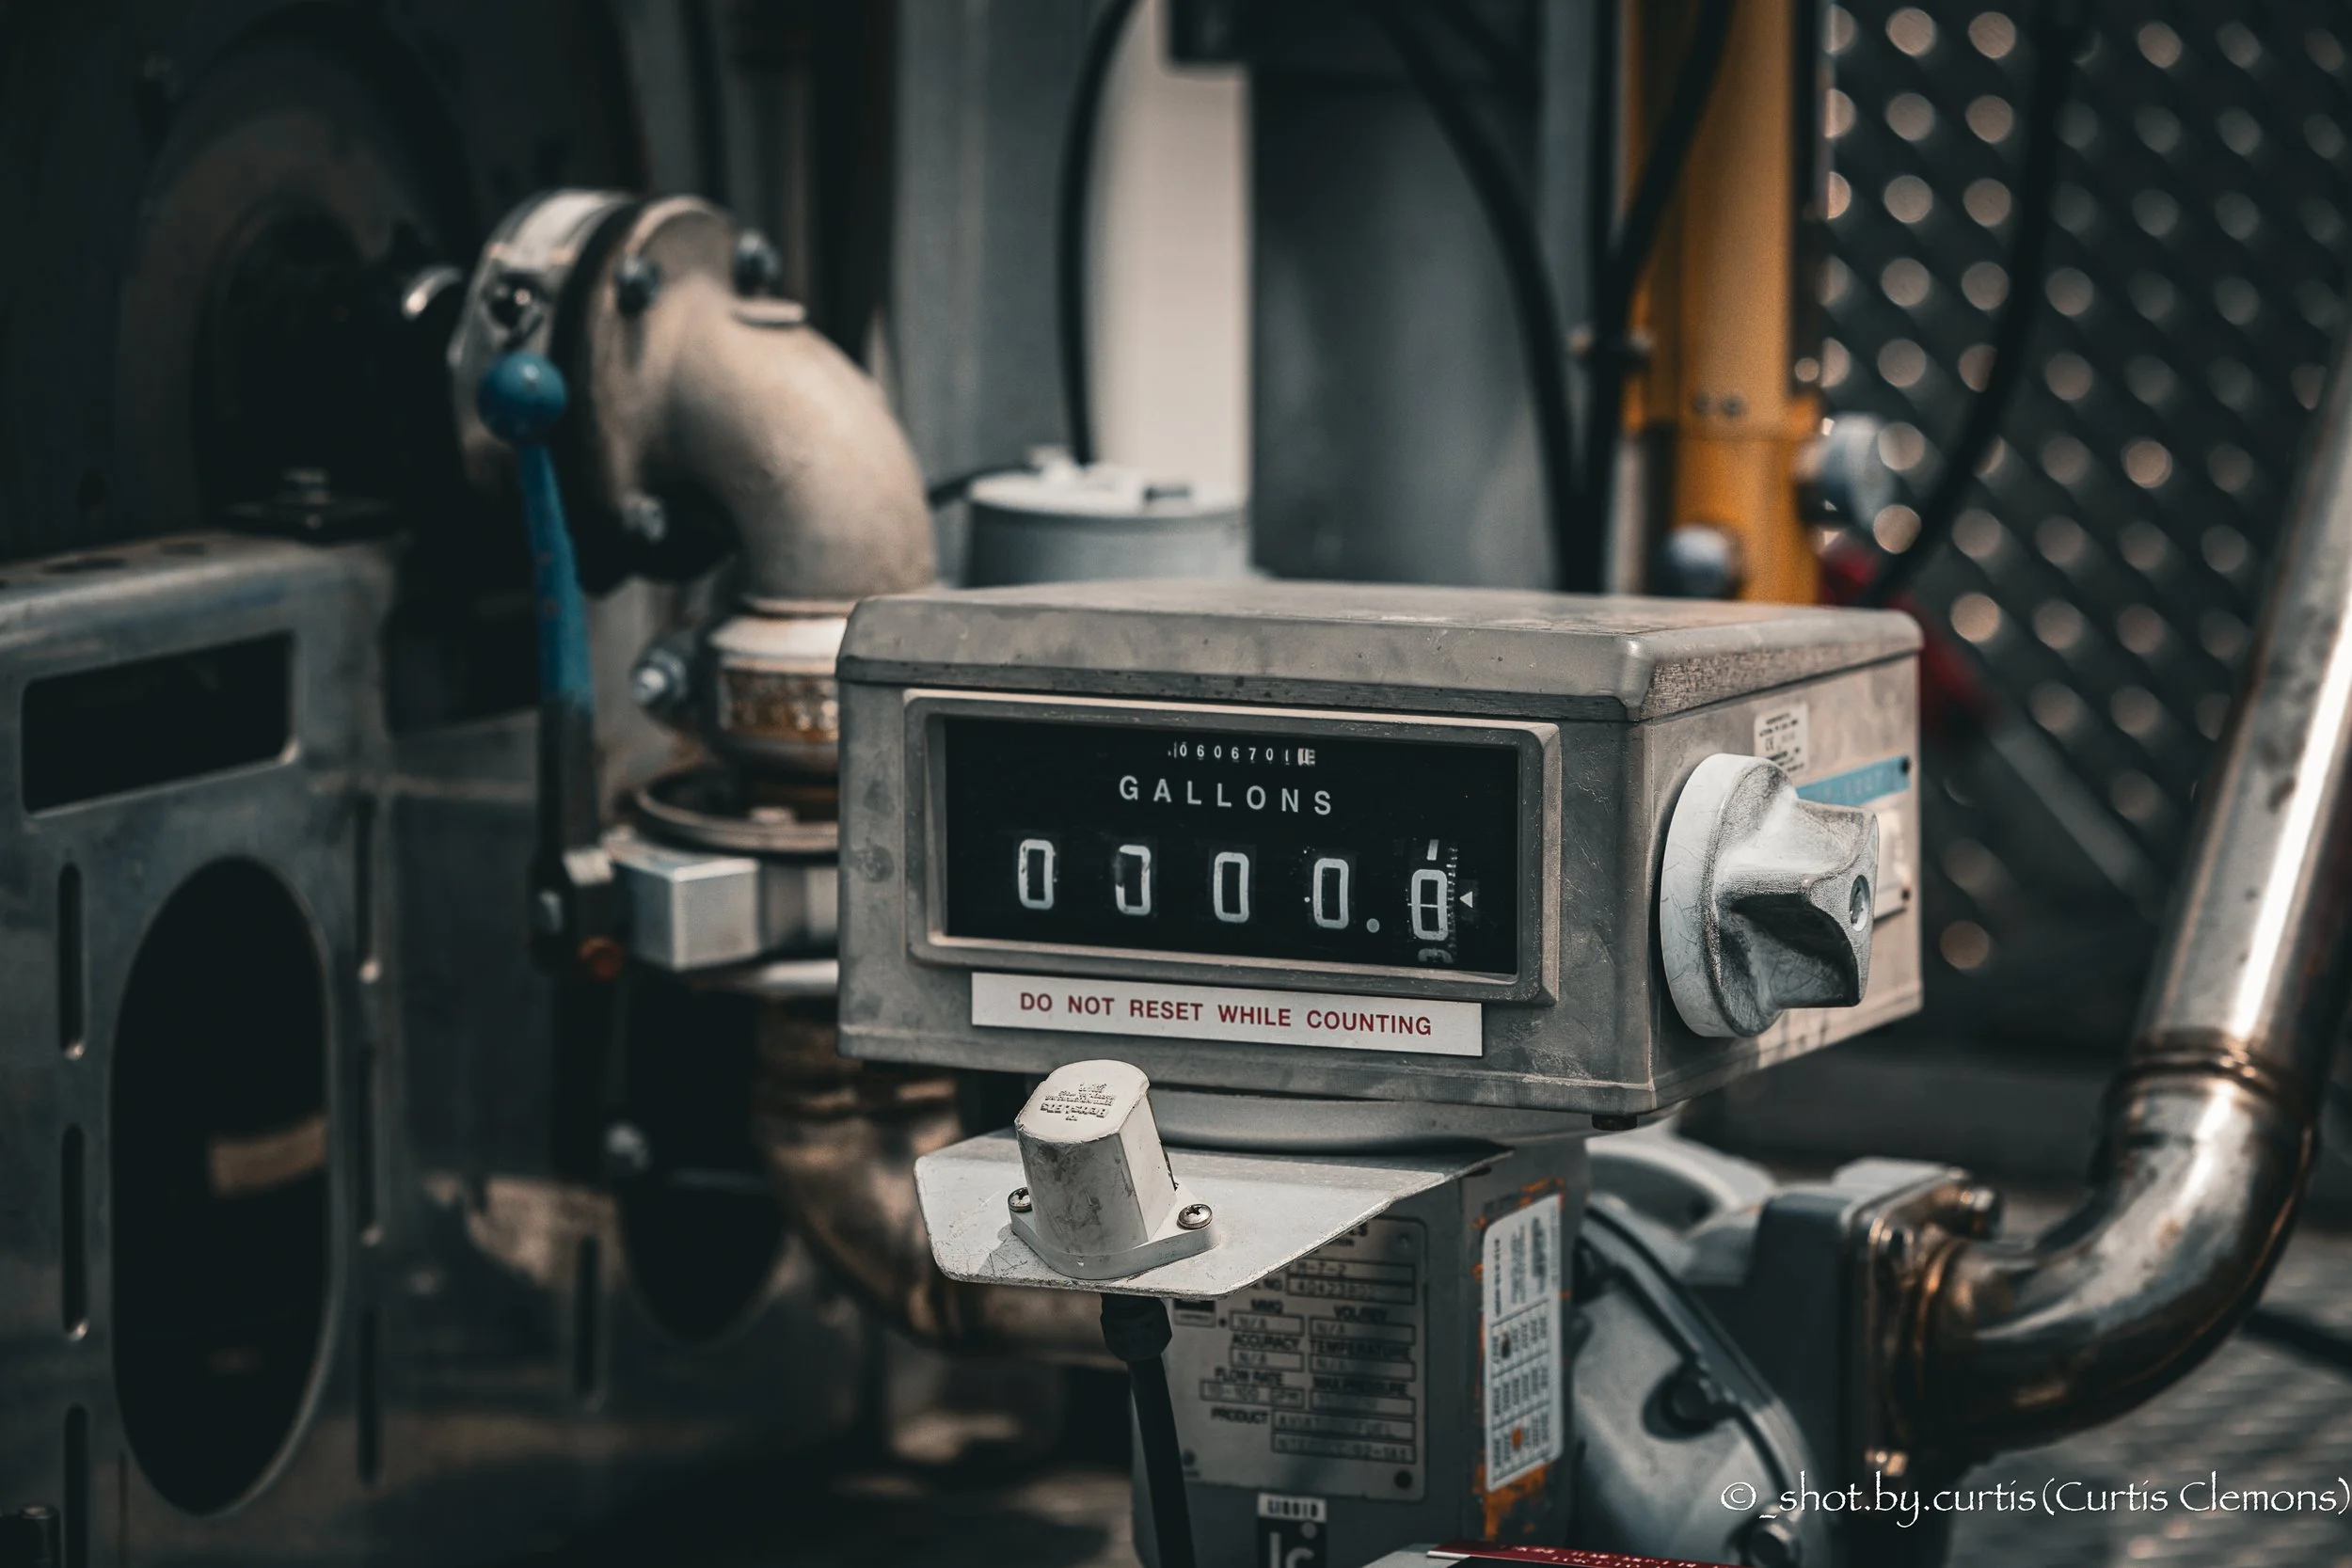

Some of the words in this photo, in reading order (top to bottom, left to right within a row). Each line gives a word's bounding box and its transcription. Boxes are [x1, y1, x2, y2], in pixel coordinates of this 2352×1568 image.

[1119, 775, 1332, 816] GALLONS
[1020, 991, 1053, 1012] DO
[1068, 995, 1115, 1016] NOT
[1130, 999, 1203, 1022] RESET
[1218, 1004, 1292, 1027] WHILE
[1306, 1009, 1432, 1036] COUNTING
